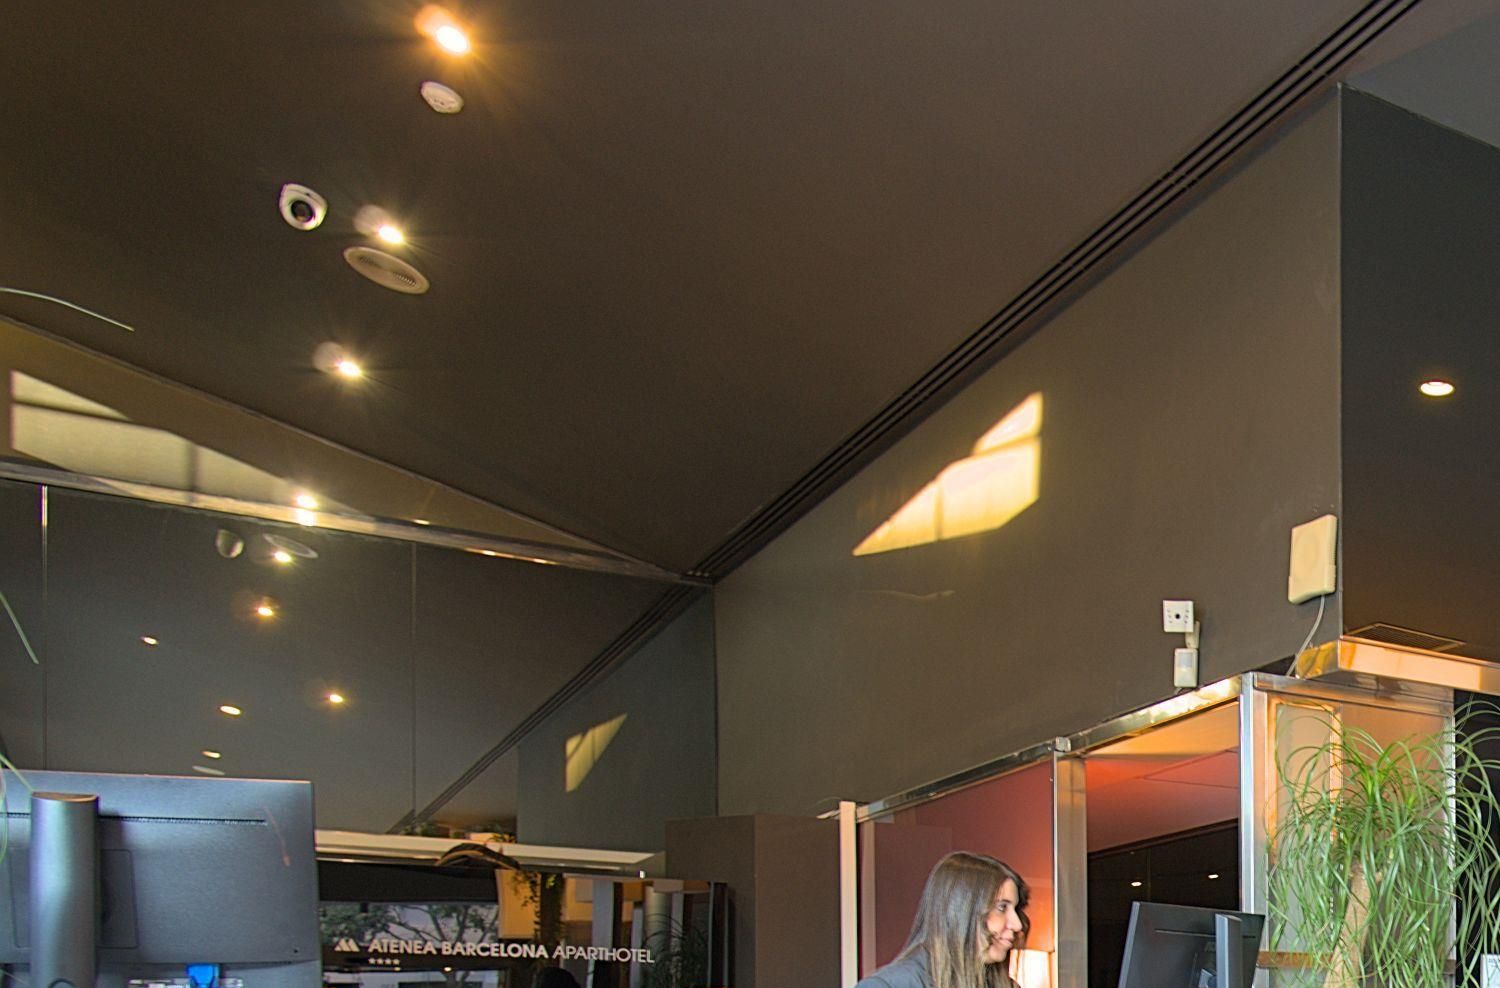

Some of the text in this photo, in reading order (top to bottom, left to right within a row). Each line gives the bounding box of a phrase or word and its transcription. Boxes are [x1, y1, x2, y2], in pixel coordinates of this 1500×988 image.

[368, 938, 655, 963] ATENEA BARCELONA APARTHOTEL
